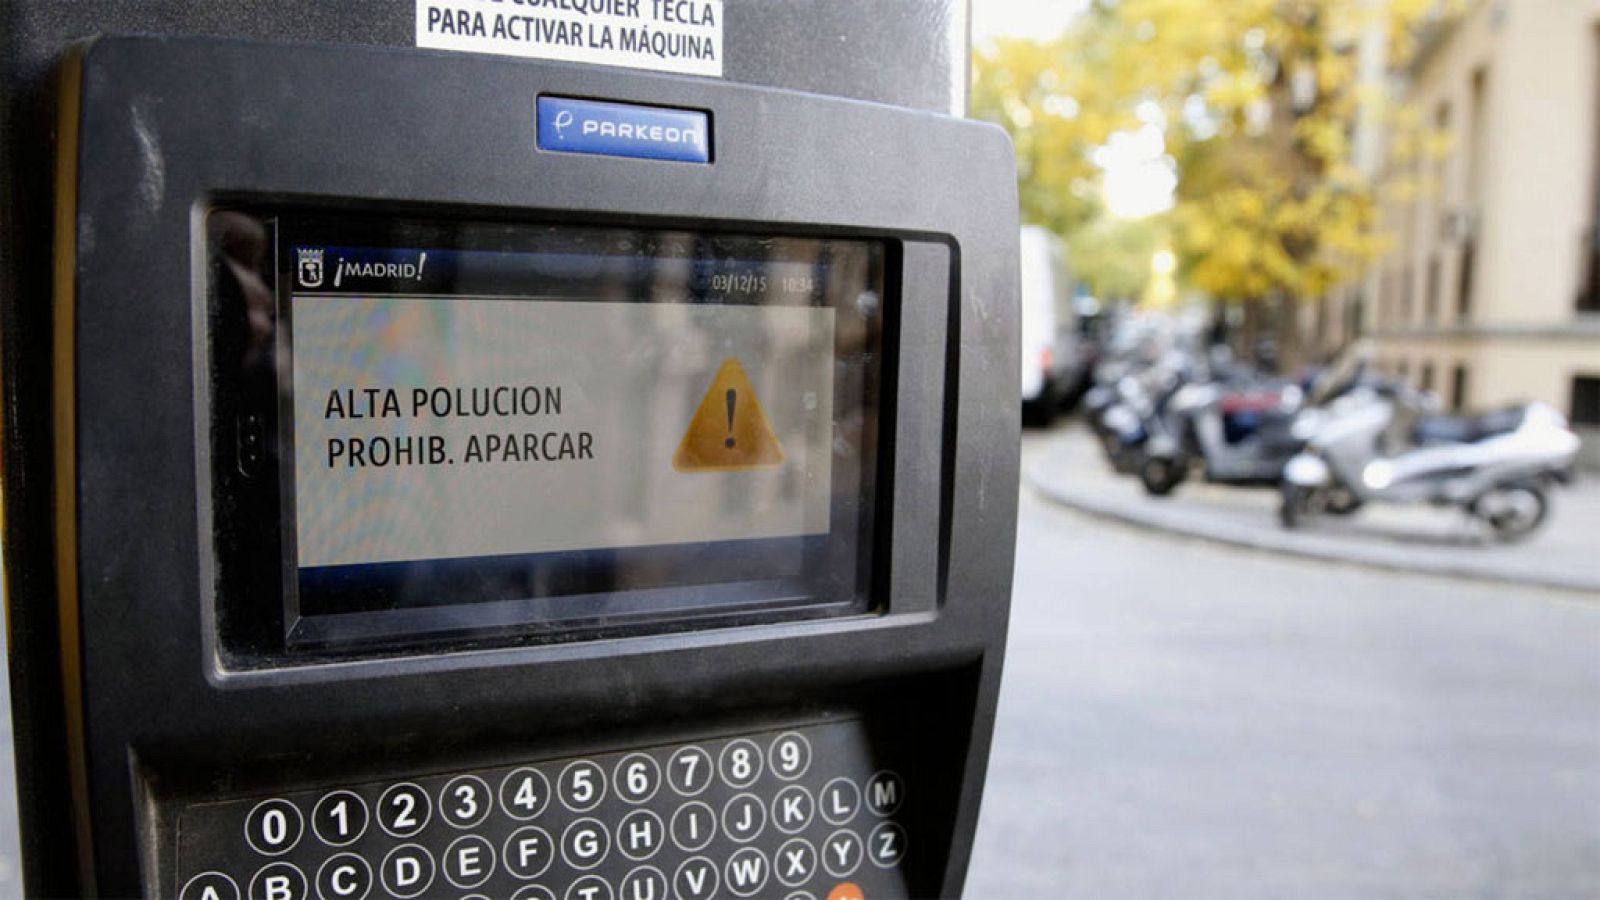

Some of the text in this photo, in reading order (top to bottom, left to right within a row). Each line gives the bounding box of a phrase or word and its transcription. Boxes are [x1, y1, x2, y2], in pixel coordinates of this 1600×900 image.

[651, 0, 715, 27] TECLA
[427, 6, 715, 61] PARA ACTIVAR LA MÁQUINA
[582, 118, 700, 144] PARKEON
[712, 273, 767, 294] 03/12/15
[325, 386, 562, 419] ALTA POLUCION
[328, 432, 594, 468] PROHIB. APARCAR
[263, 739, 800, 845] 0 1 2 3 4 5 6 7 8 9
[266, 781, 895, 900] B C D E F G H I J K L M
[684, 867, 707, 896] V
[731, 857, 762, 887] W
[785, 848, 807, 878] X
[832, 839, 852, 867] Y
[879, 832, 896, 859] Z
